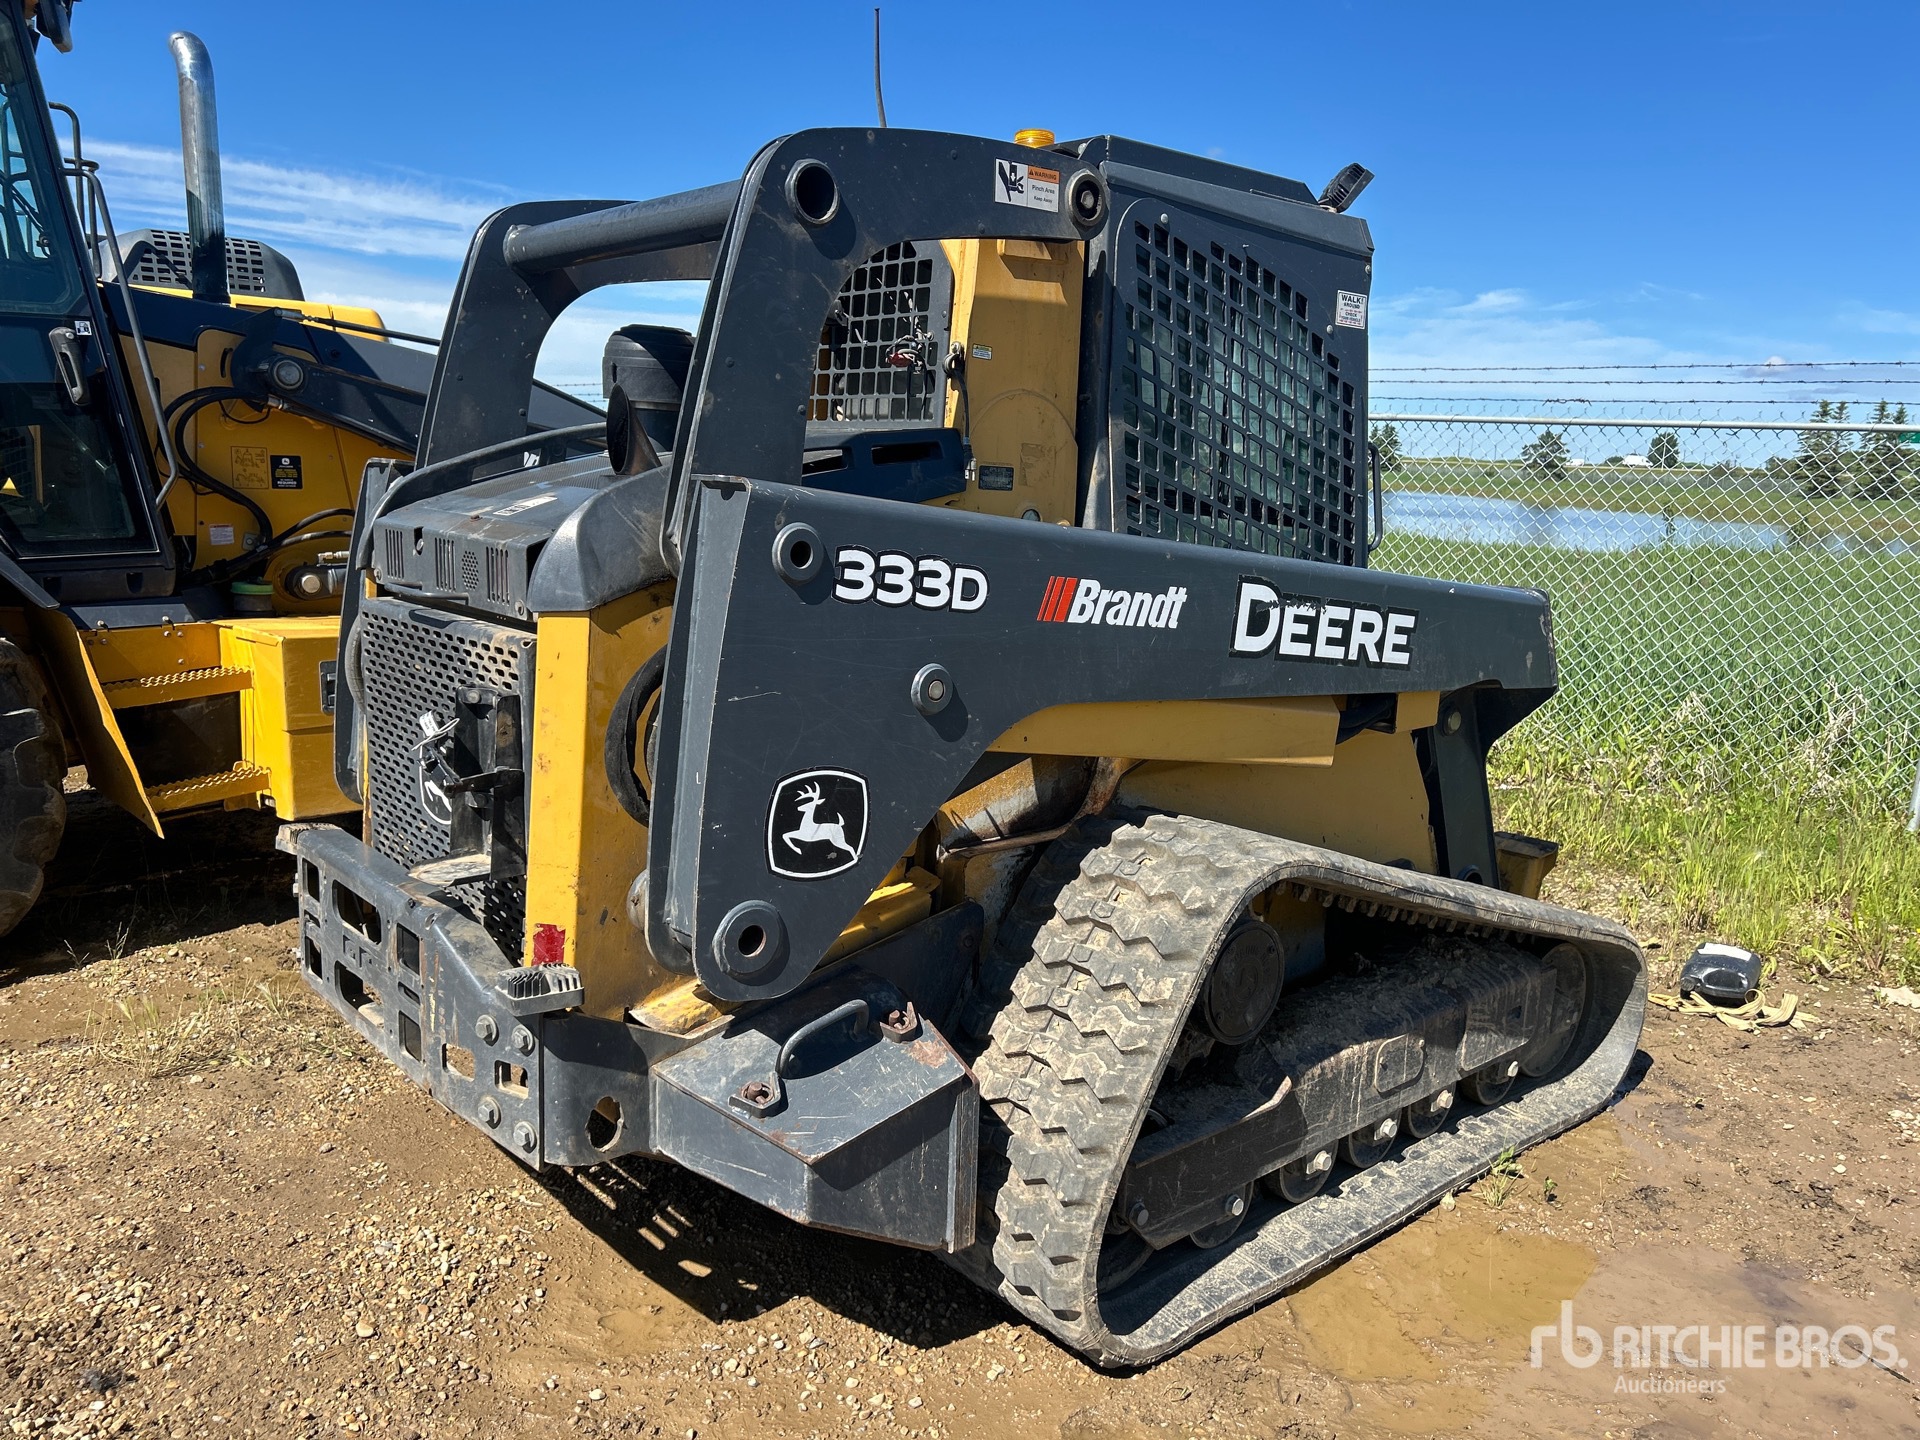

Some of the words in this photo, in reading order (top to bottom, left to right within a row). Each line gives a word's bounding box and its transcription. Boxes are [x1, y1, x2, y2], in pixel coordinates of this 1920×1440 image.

[1031, 184, 1045, 193] Pinch
[1045, 186, 1056, 195] Area
[1034, 171, 1057, 181] WARNING
[1343, 302, 1361, 310] AROUND
[834, 548, 989, 612] 333D
[1067, 578, 1188, 629] Brandt
[1233, 581, 1416, 665] DEERE
